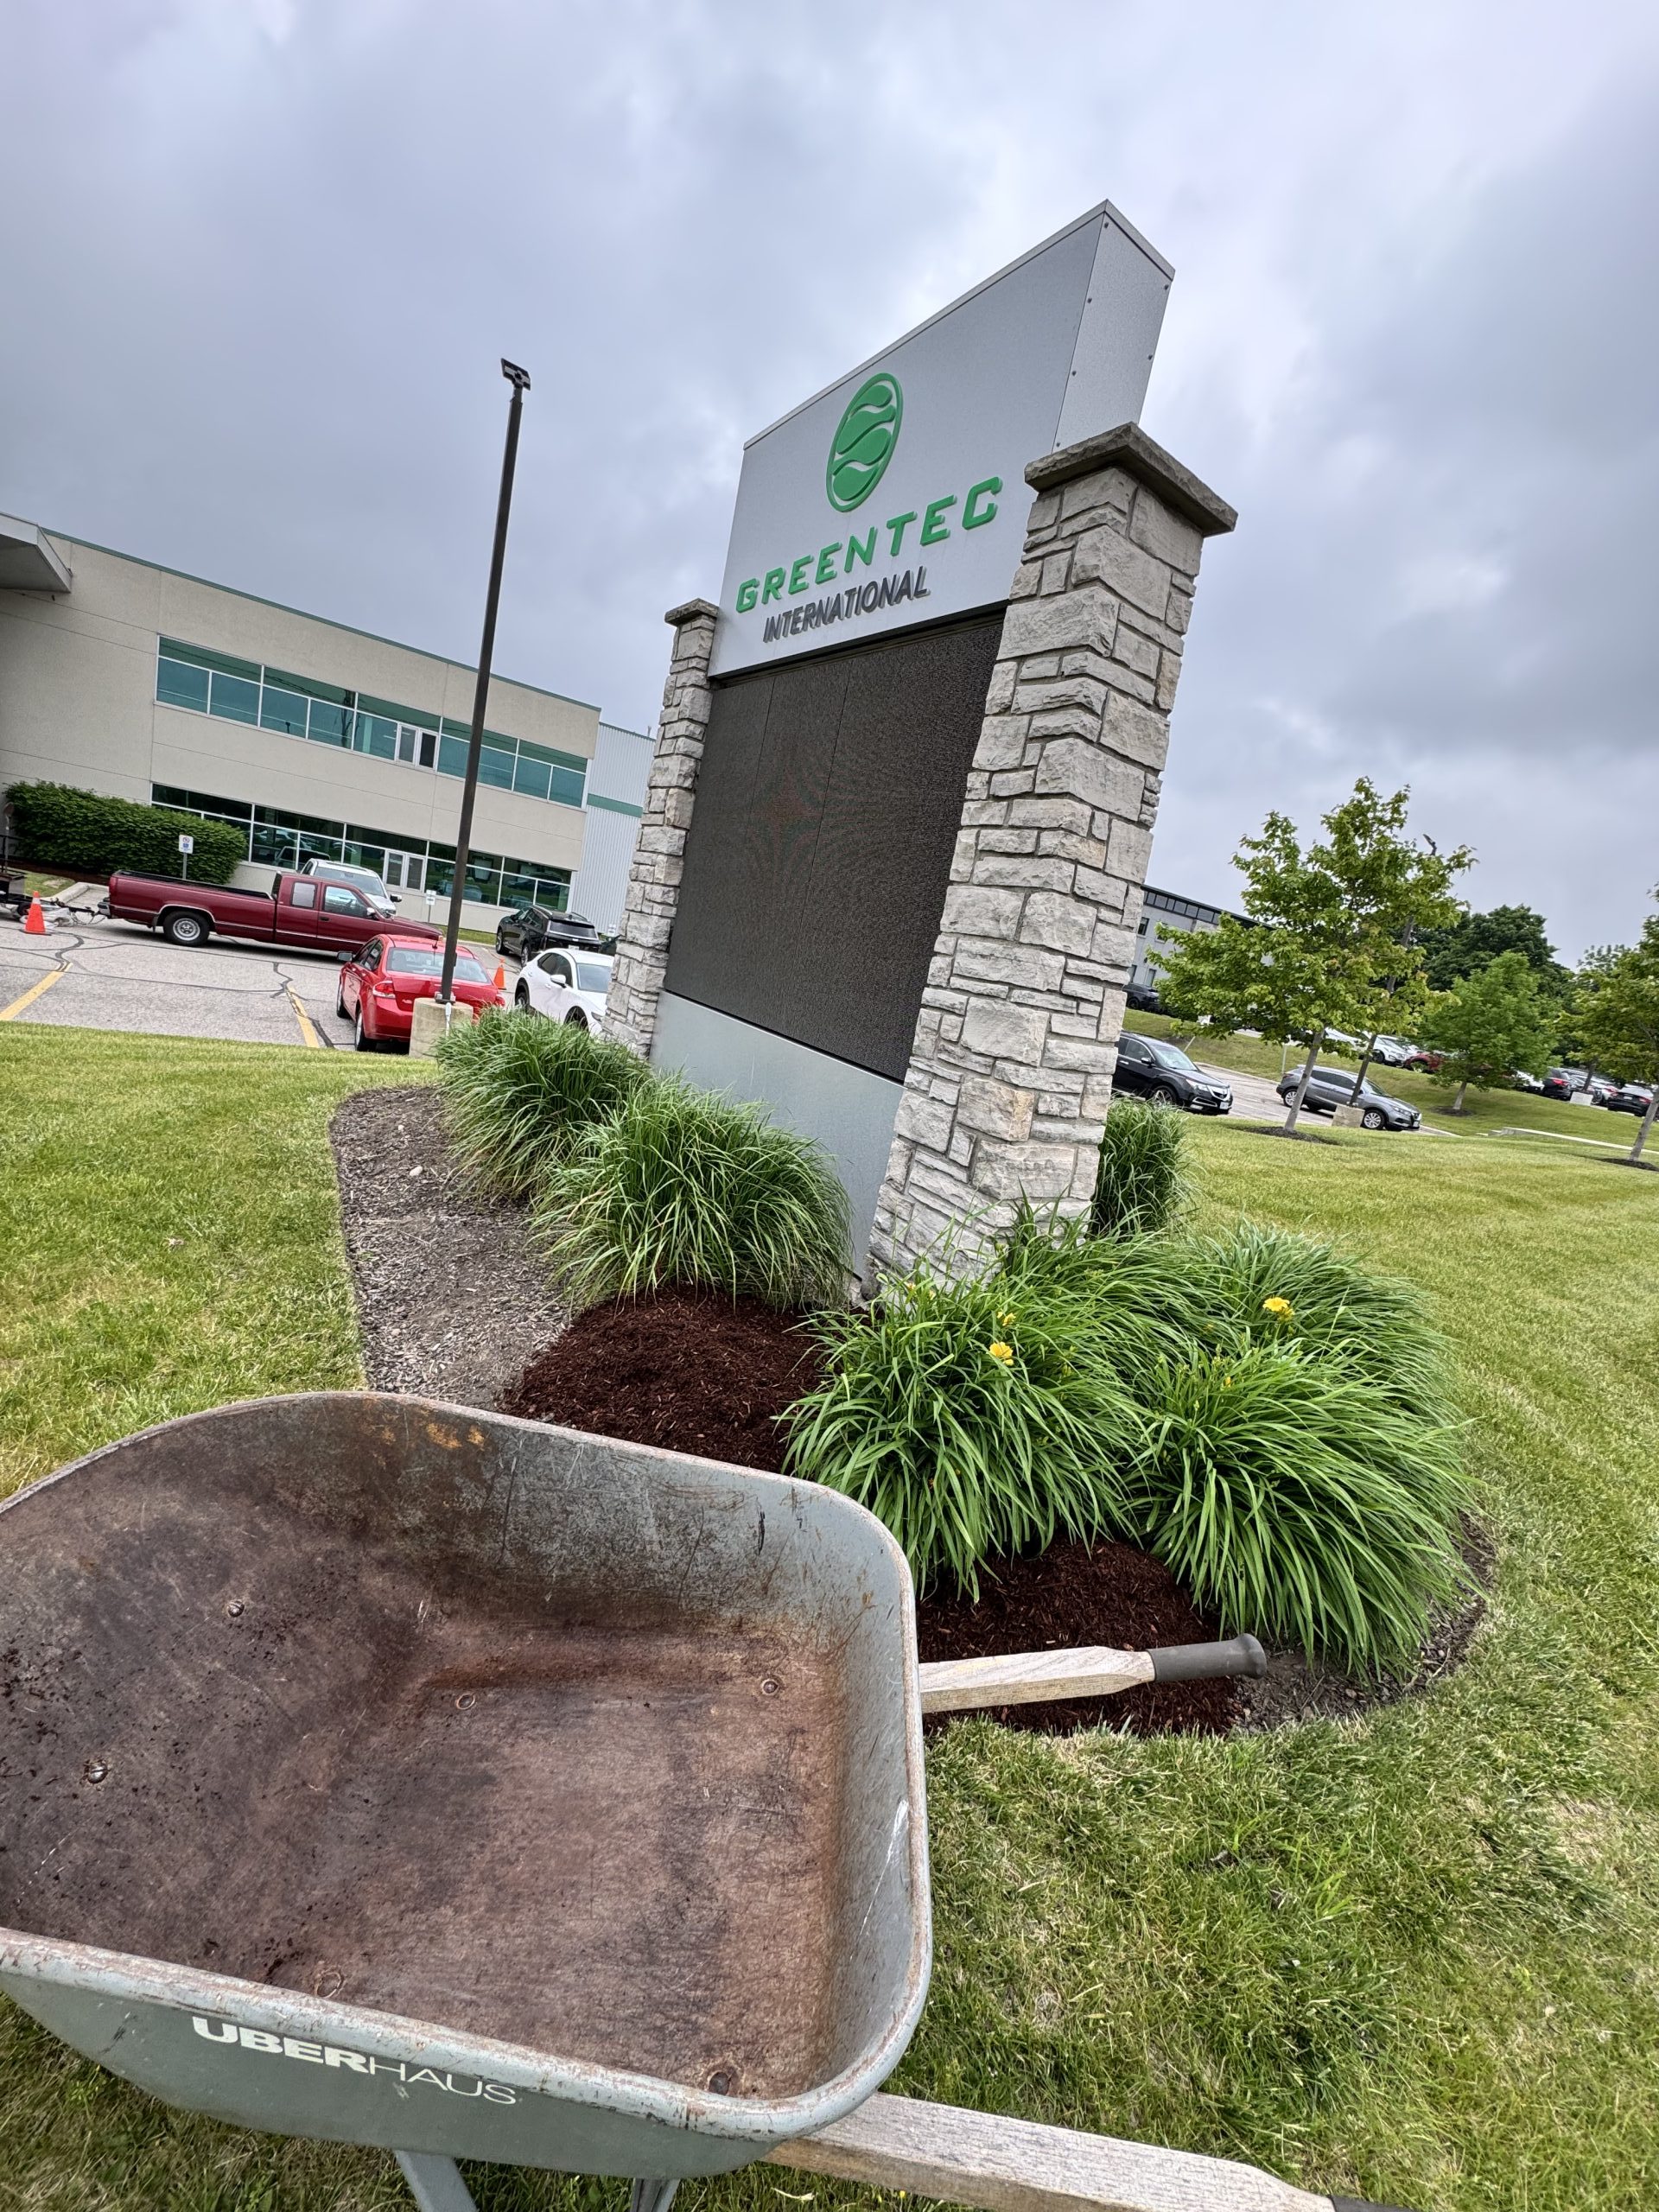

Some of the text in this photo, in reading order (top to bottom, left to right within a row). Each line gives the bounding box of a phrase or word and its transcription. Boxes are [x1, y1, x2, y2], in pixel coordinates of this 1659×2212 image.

[735, 476, 1002, 613] GREENTEC
[763, 566, 930, 642] INTERNATIONAL
[192, 2016, 517, 2104] UBERHAUS
